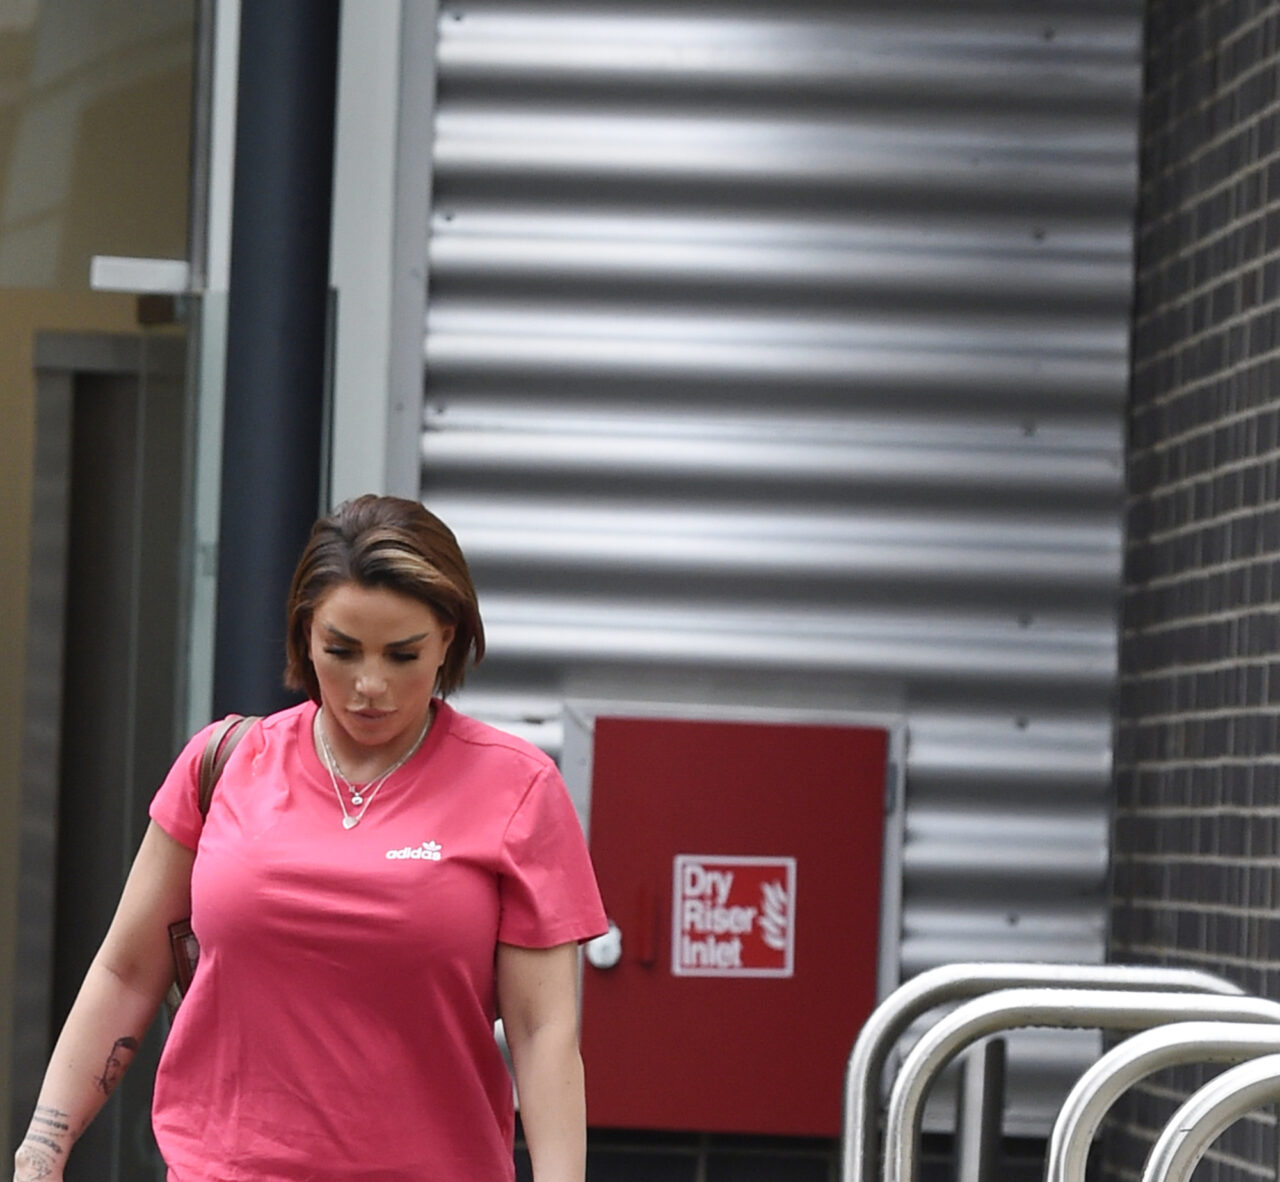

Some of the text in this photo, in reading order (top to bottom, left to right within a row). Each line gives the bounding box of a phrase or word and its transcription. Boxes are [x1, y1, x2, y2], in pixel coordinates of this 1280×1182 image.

[385, 847, 441, 861] adidas
[683, 864, 733, 904] Dry
[683, 899, 757, 934] Riser
[682, 934, 743, 967] Inlet
